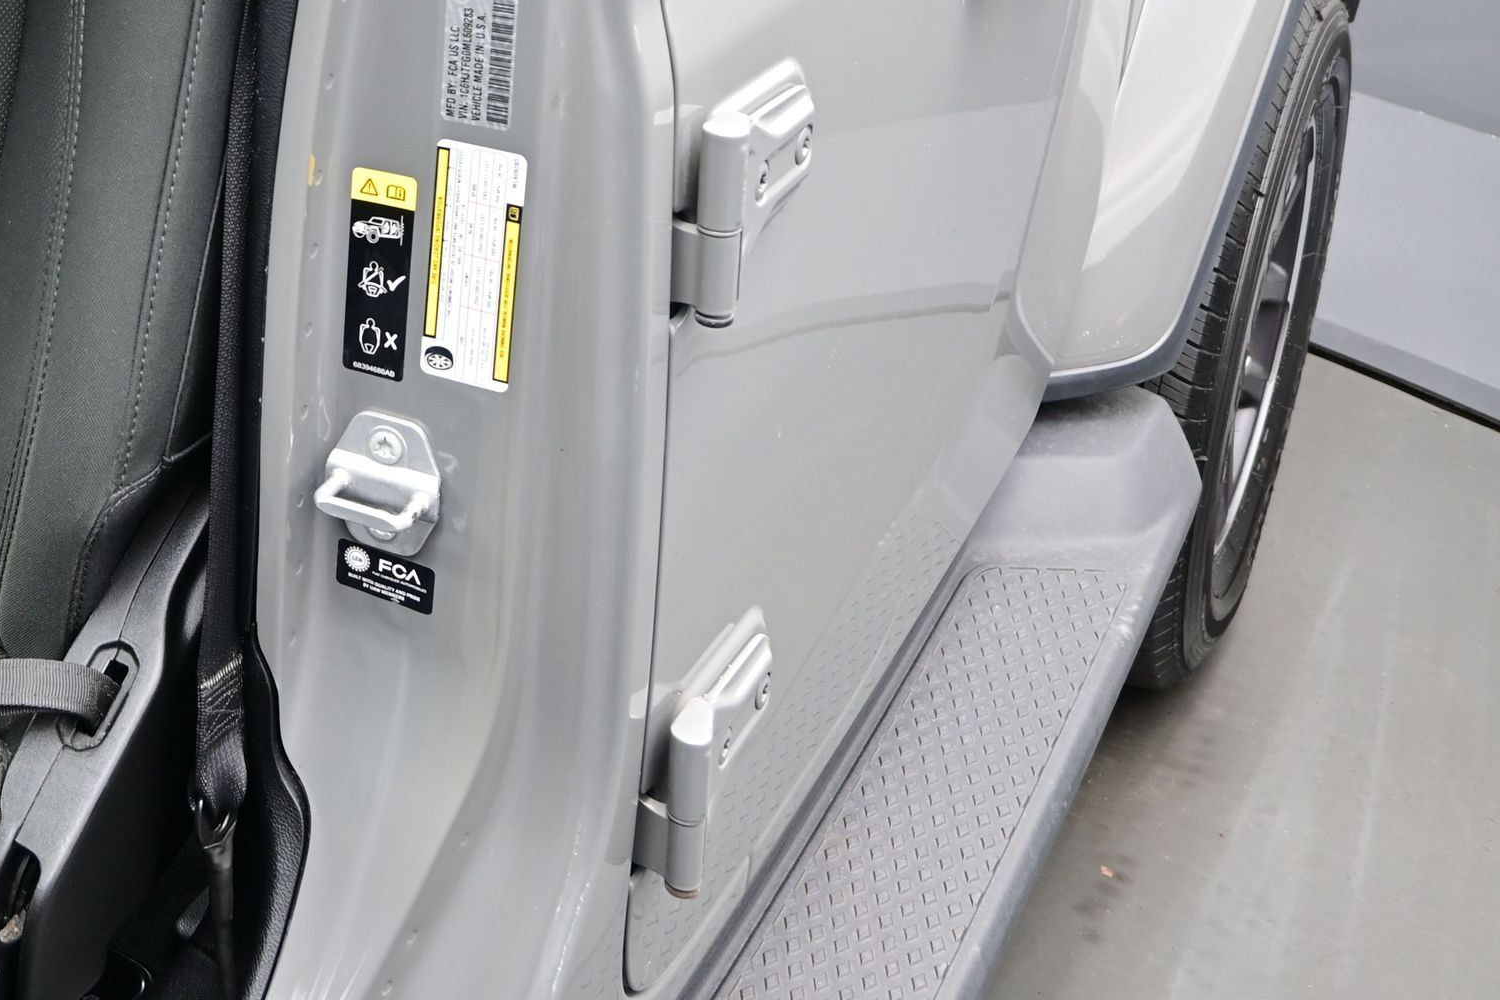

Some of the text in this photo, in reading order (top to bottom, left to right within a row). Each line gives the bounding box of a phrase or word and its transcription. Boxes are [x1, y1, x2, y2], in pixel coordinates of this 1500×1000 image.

[446, 26, 460, 117] MFD BY: FCA US LLC
[471, 12, 487, 121] VEHICLE MADE IN: U.S.A.
[458, 101, 469, 119] VIN:
[378, 558, 421, 585] FCA
[374, 582, 395, 592] QUALITY
[407, 592, 420, 602] PRIDE
